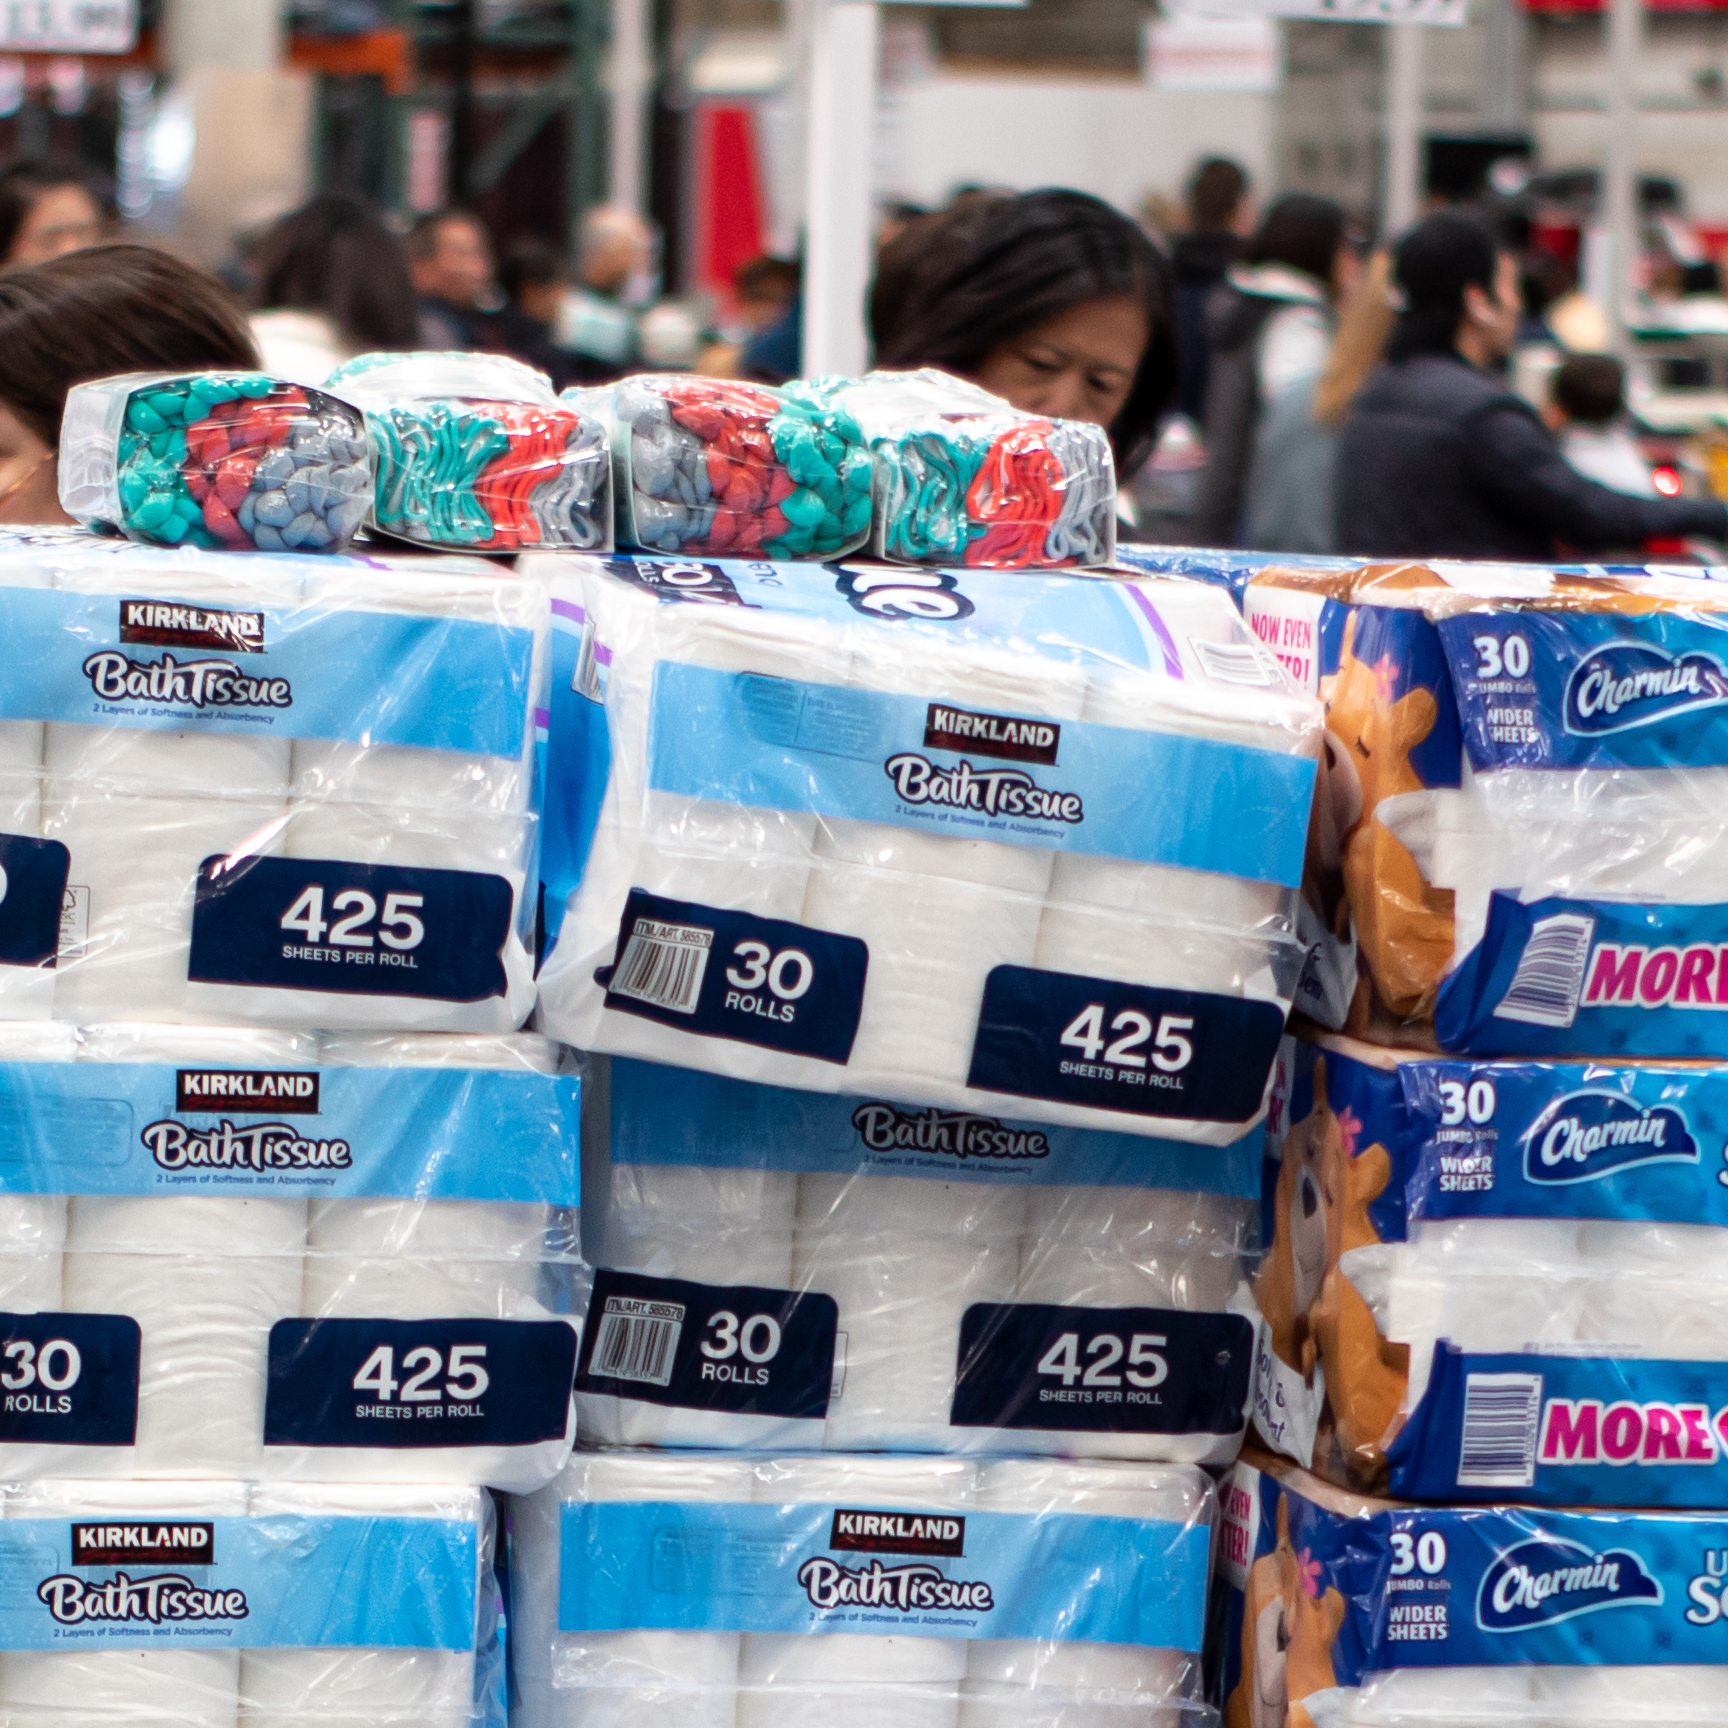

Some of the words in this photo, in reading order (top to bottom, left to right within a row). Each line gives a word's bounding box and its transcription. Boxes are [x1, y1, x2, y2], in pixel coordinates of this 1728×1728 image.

[128, 605, 261, 635] KIRKLAND
[1283, 618, 1311, 649] EVEN
[1473, 636, 1530, 678] 30
[1577, 658, 1702, 718] Charmin
[933, 710, 1055, 750] KIRKLAND
[281, 886, 425, 950] 425
[282, 945, 340, 965] SHEETS
[345, 949, 375, 966] PER
[380, 950, 418, 968] ROLL
[725, 941, 813, 998] 30
[724, 991, 795, 1023] ROLLS
[1060, 1005, 1194, 1072] 425
[183, 1073, 315, 1099] KIRKLAND
[1439, 1081, 1496, 1125] 30
[1541, 1106, 1667, 1166] Charmin
[0, 1340, 81, 1391] 30
[353, 1345, 490, 1402] 425
[1538, 1399, 1716, 1465] MORE
[78, 1526, 209, 1551] KIRKLAND
[837, 1513, 961, 1542] KIRKLAND
[1389, 1532, 1447, 1575] 30
[1492, 1553, 1621, 1613] Charmin
[53, 1628, 60, 1637] 2
[62, 1628, 96, 1640] Layers
[98, 1626, 107, 1636] of
[108, 1626, 149, 1637] Softness
[151, 1625, 171, 1636] and
[173, 1625, 232, 1638] Absorbency
[1388, 1623, 1448, 1640] SHEETS
[1389, 1605, 1447, 1622] WIDER
